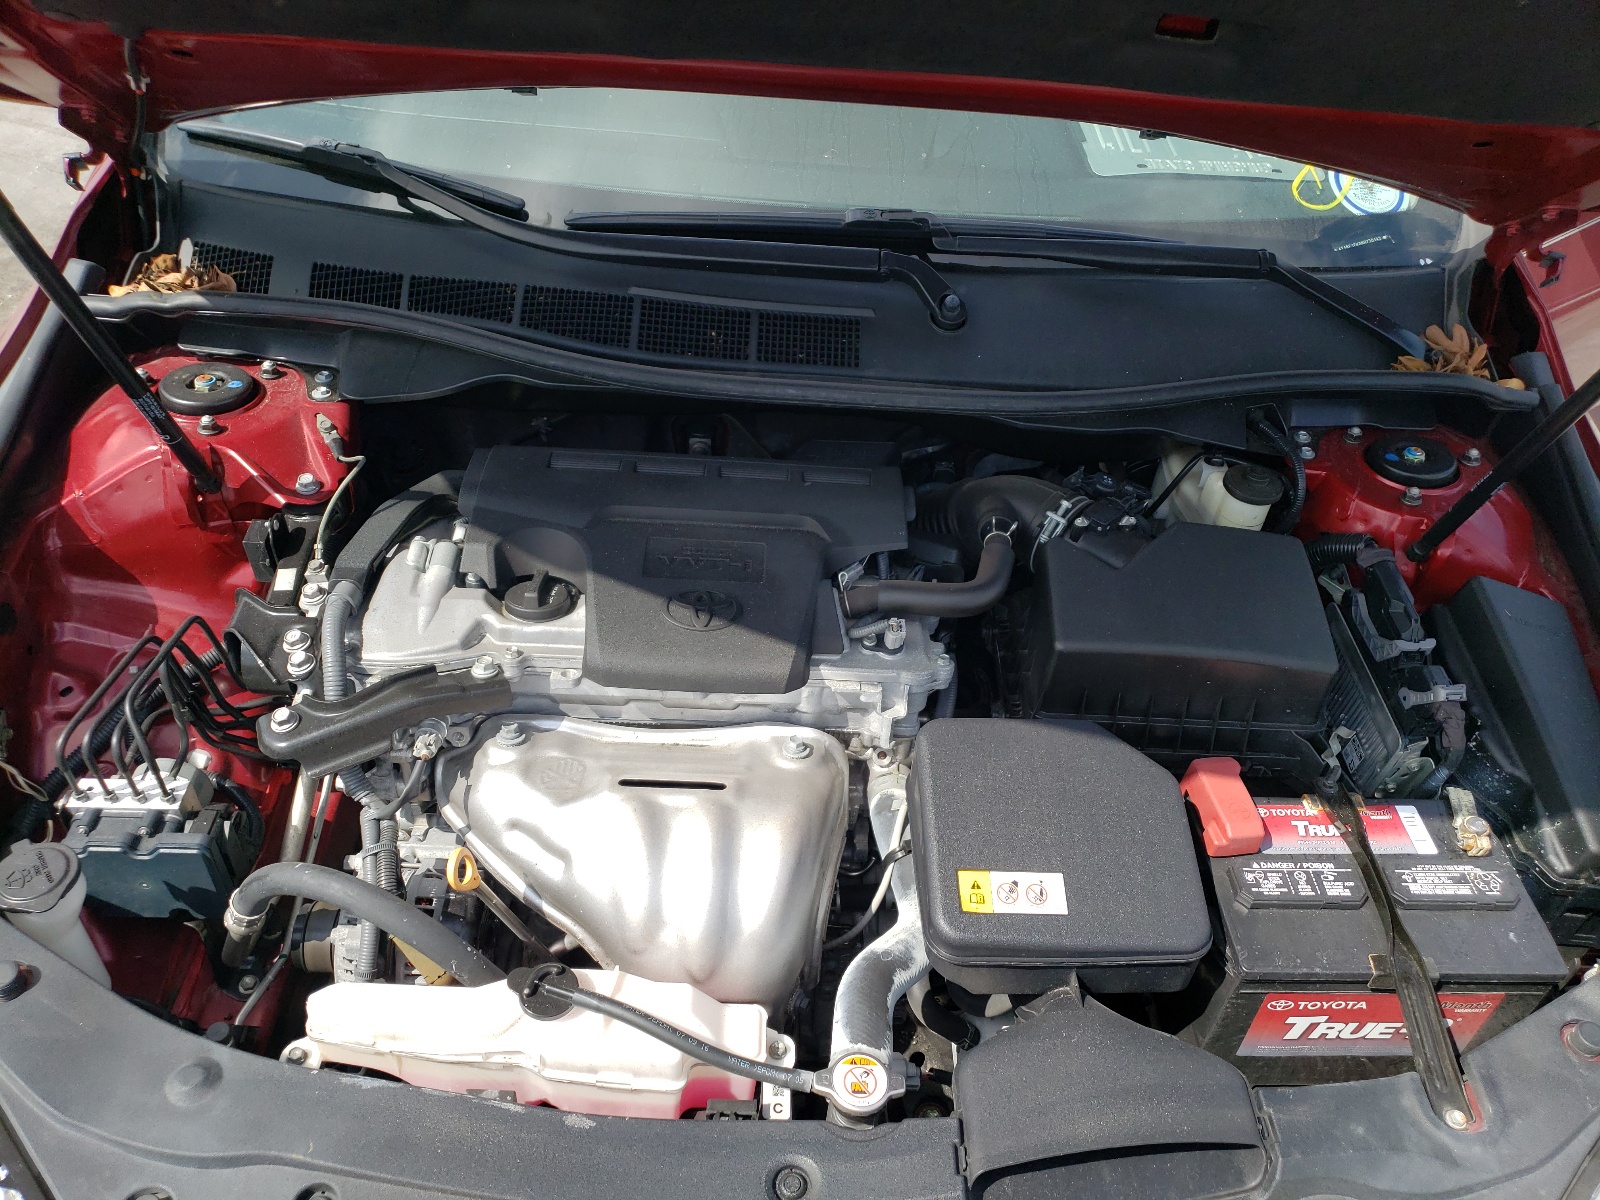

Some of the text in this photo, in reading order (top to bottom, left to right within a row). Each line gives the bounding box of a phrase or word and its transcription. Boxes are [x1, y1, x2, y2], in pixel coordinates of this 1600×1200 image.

[1270, 807, 1316, 817] TOYOTA
[1260, 861, 1296, 869] DANGER
[1298, 1000, 1367, 1010] TOYOTA
[772, 1103, 784, 1114] C
